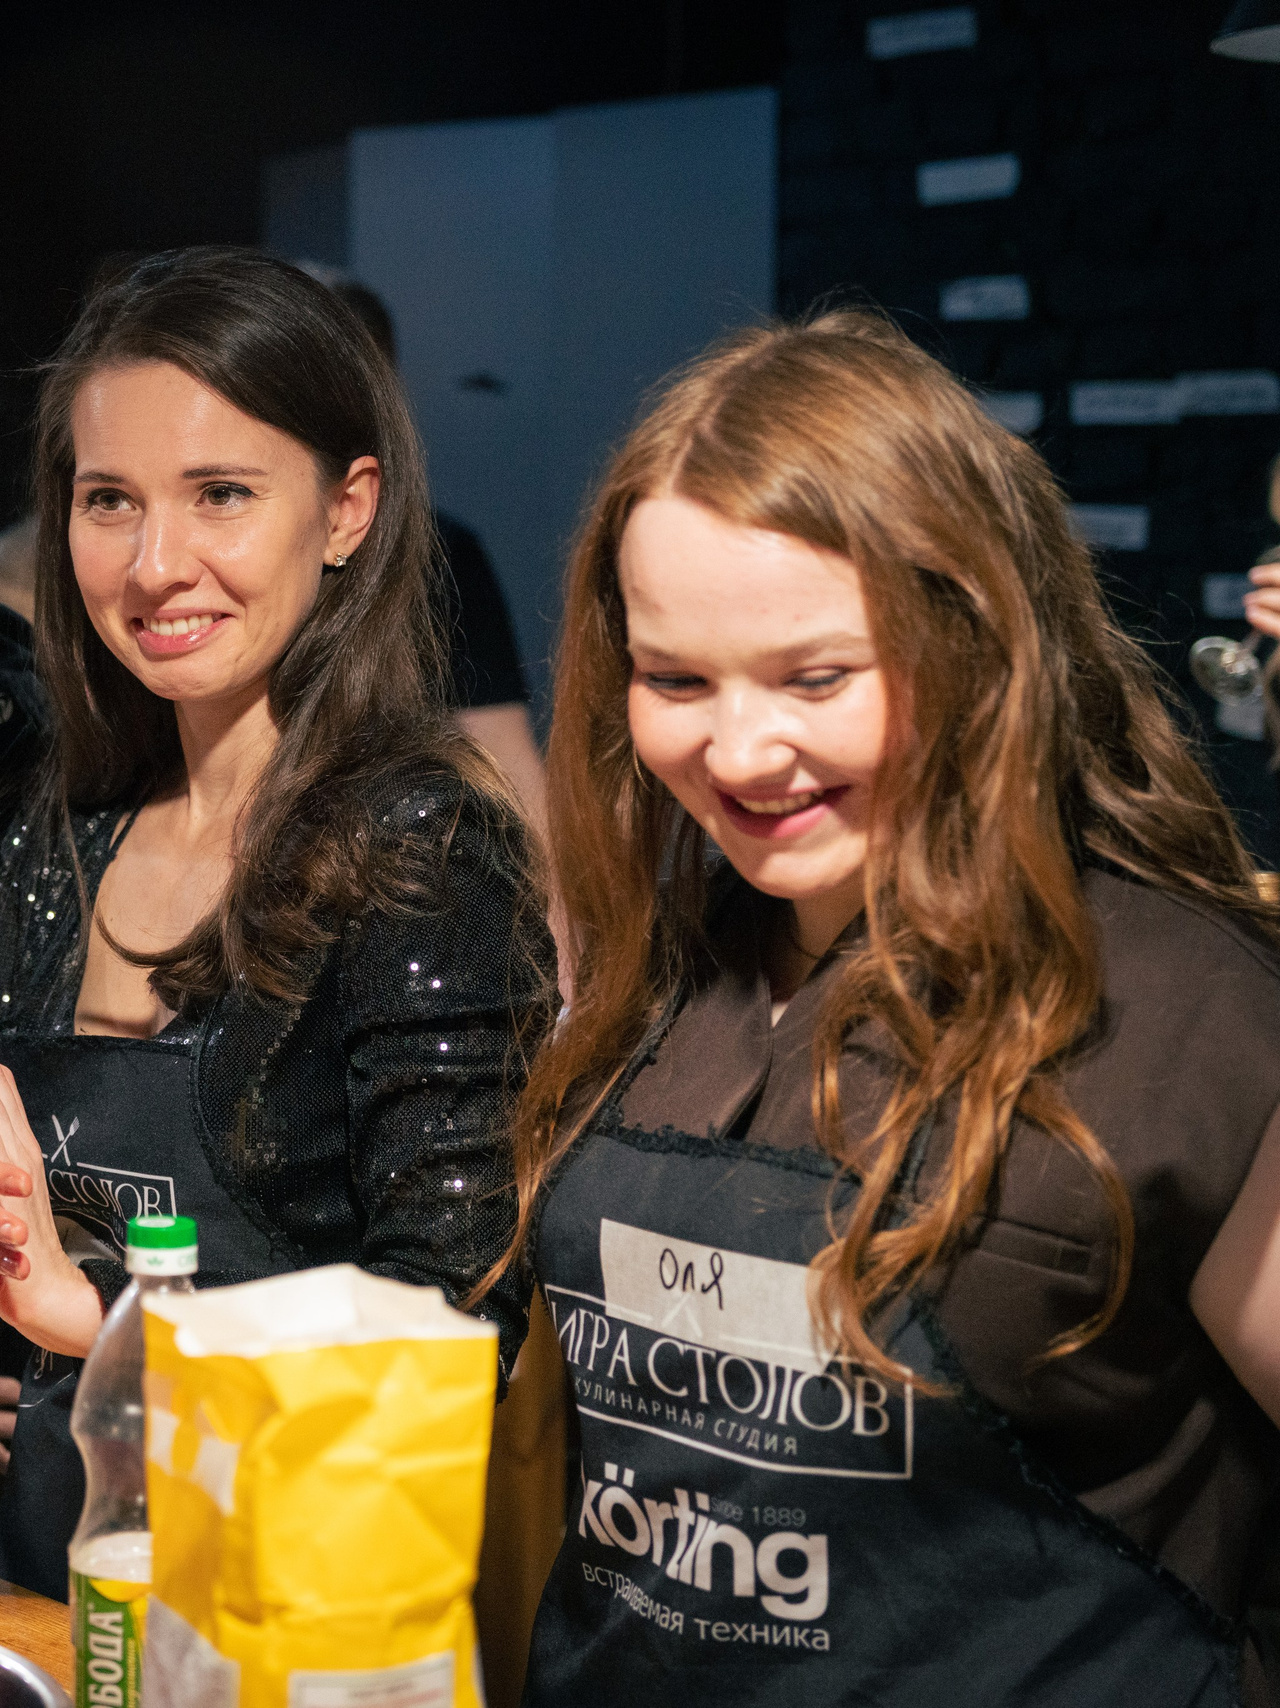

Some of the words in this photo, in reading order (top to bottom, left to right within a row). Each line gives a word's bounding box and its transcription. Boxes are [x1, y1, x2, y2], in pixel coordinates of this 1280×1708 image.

[647, 1336, 891, 1438] СТОЛОВ
[713, 1419, 799, 1457] СТУДИЯ
[752, 1505, 807, 1528] 1889
[693, 1617, 831, 1652] техника
[87, 1611, 124, 1708] БОДА
